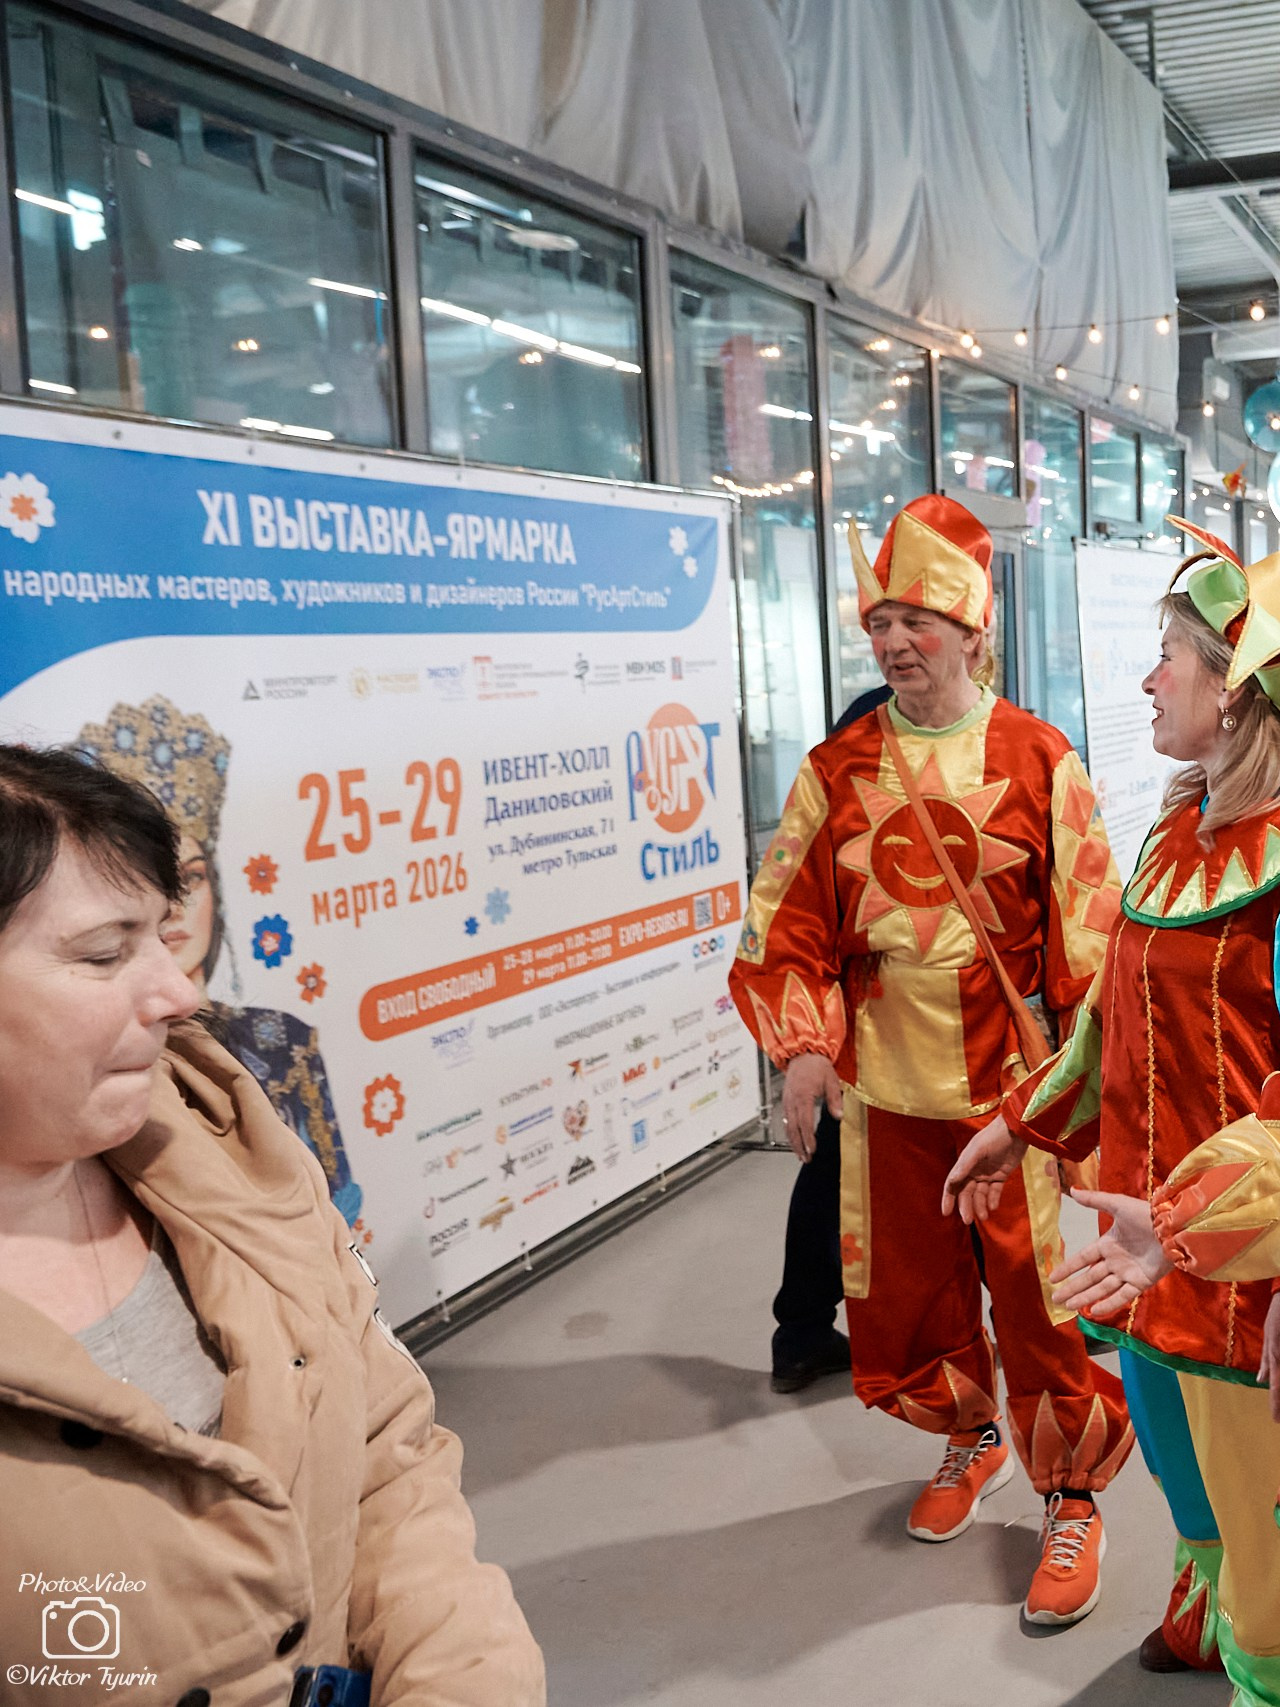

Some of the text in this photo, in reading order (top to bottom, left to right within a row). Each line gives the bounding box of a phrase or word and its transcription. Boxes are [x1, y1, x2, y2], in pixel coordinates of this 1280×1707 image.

[196, 489, 577, 565] XI ВЫСТАВКА-ЯРМАРКА
[3, 568, 151, 606] народных
[157, 574, 278, 609] мастеров,
[280, 578, 406, 610] художников
[408, 583, 423, 603] и
[425, 576, 525, 611] дизайнеров
[526, 580, 579, 606] России
[483, 746, 610, 785] ИВЕНТ-ХОЛЛ
[298, 757, 462, 862] 25-29
[484, 779, 613, 829] Даниловский
[523, 844, 617, 875] метро Тульская
[312, 852, 468, 928] марта 2026
[376, 988, 419, 1025] ВХОД
[417, 962, 497, 1012] СВОБОДНЫЙ
